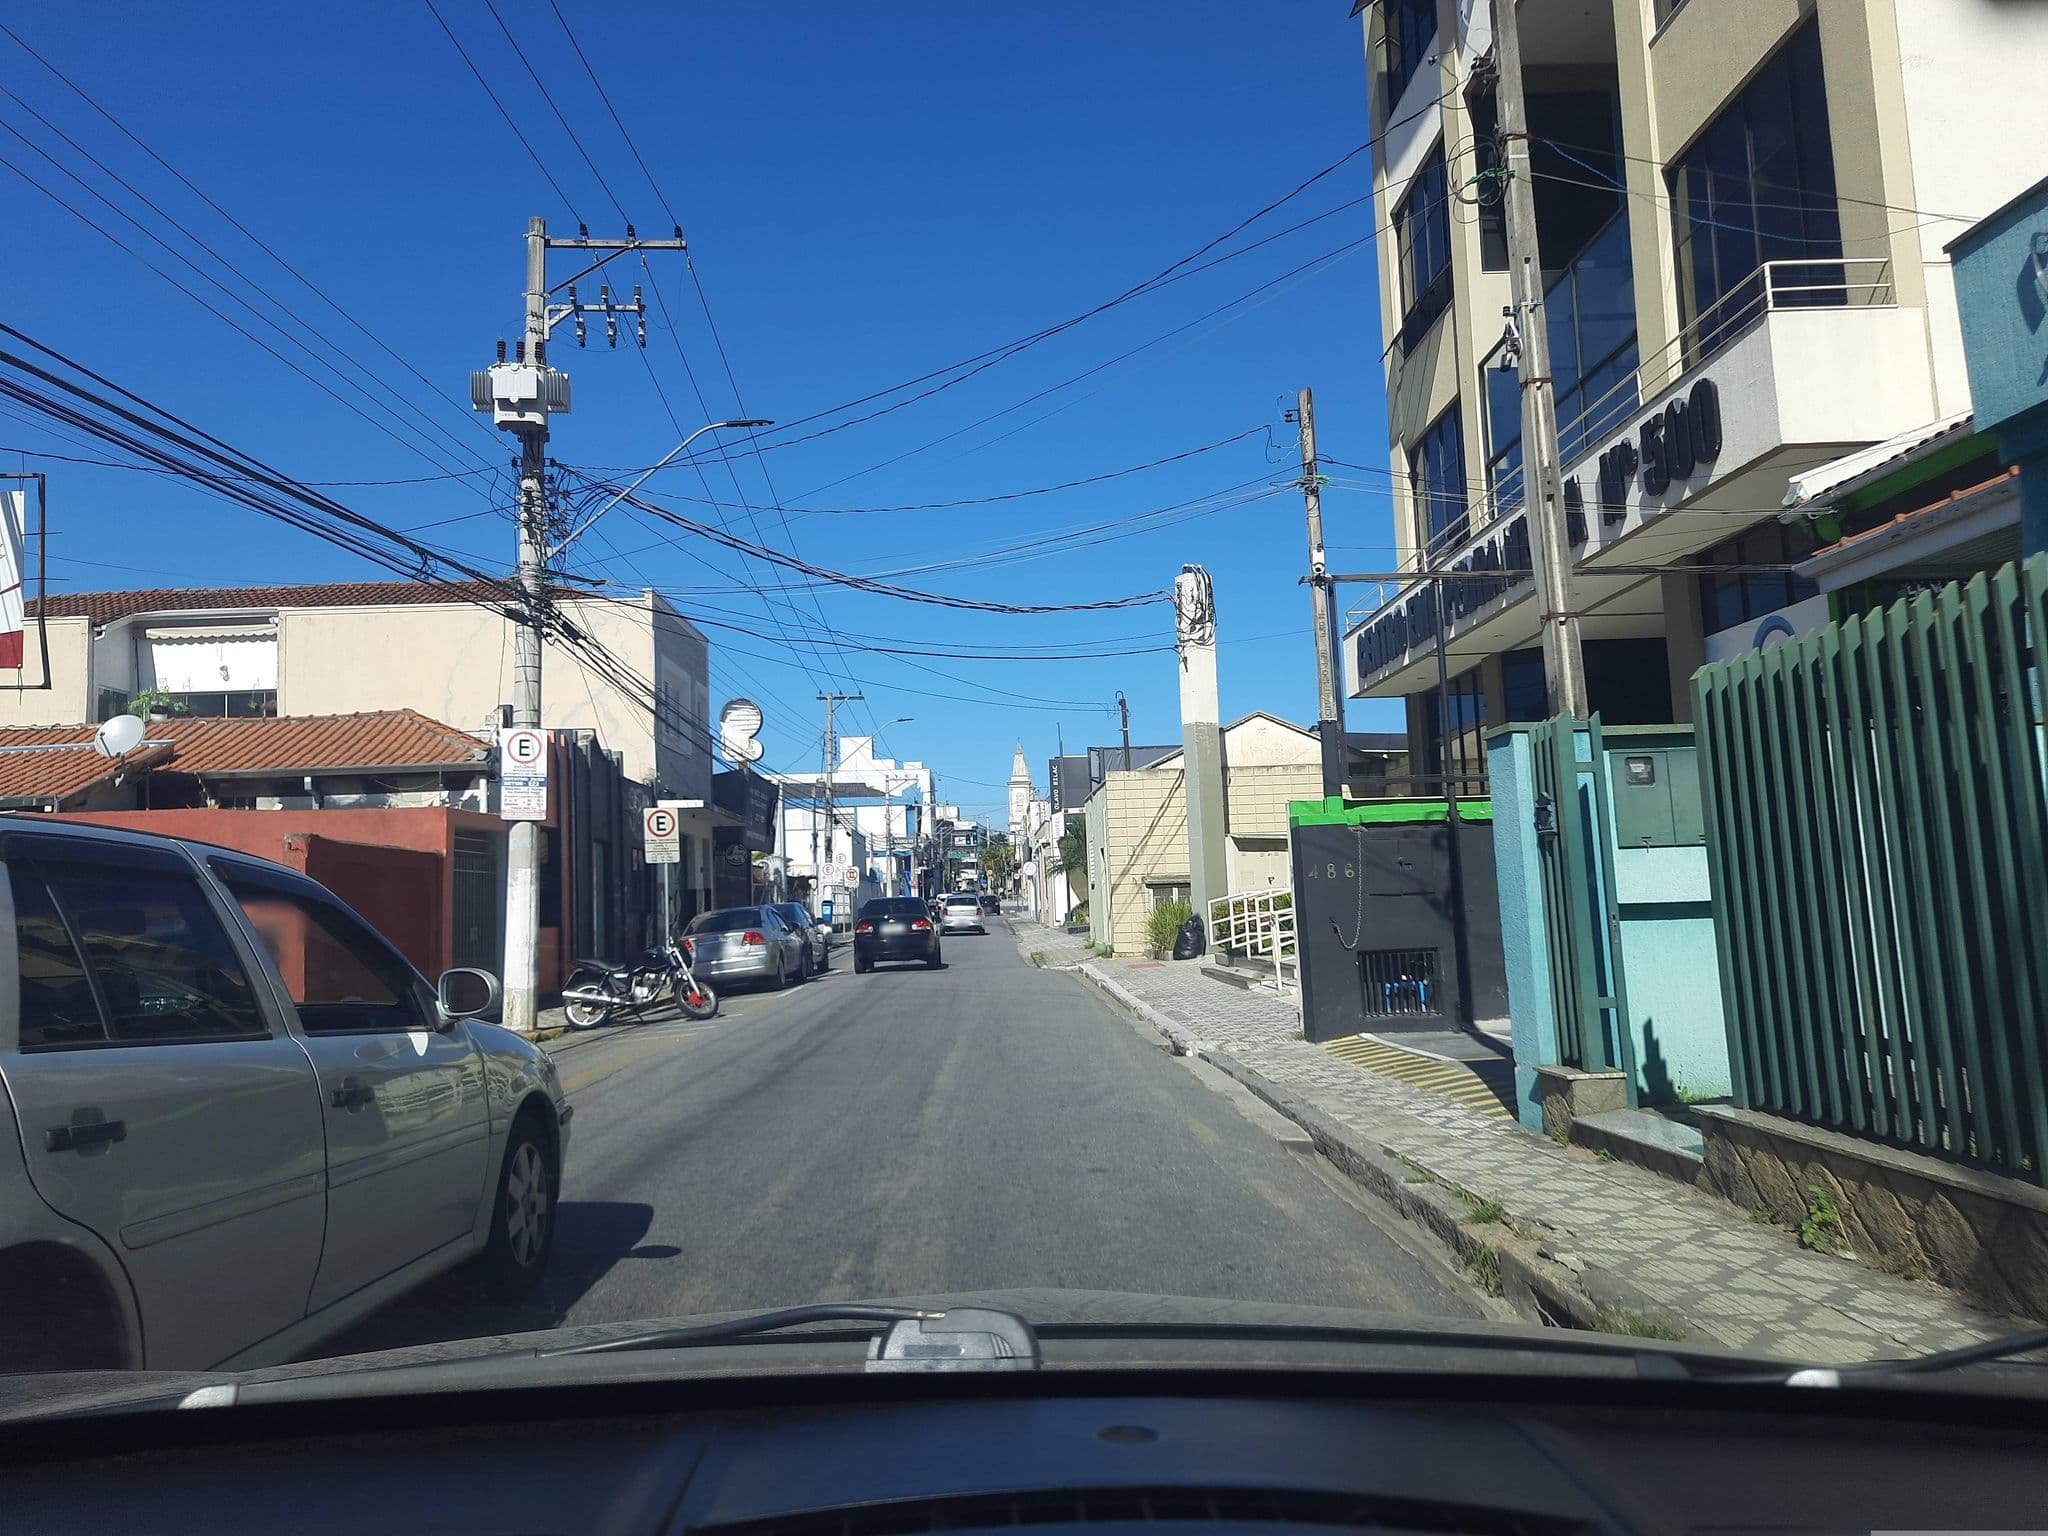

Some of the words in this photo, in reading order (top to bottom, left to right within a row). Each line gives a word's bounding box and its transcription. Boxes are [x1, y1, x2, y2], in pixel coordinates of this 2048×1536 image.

[1640, 378, 1723, 497] 500
[519, 739, 530, 756] E
[656, 816, 667, 831] E
[1307, 863, 1355, 879] 486
